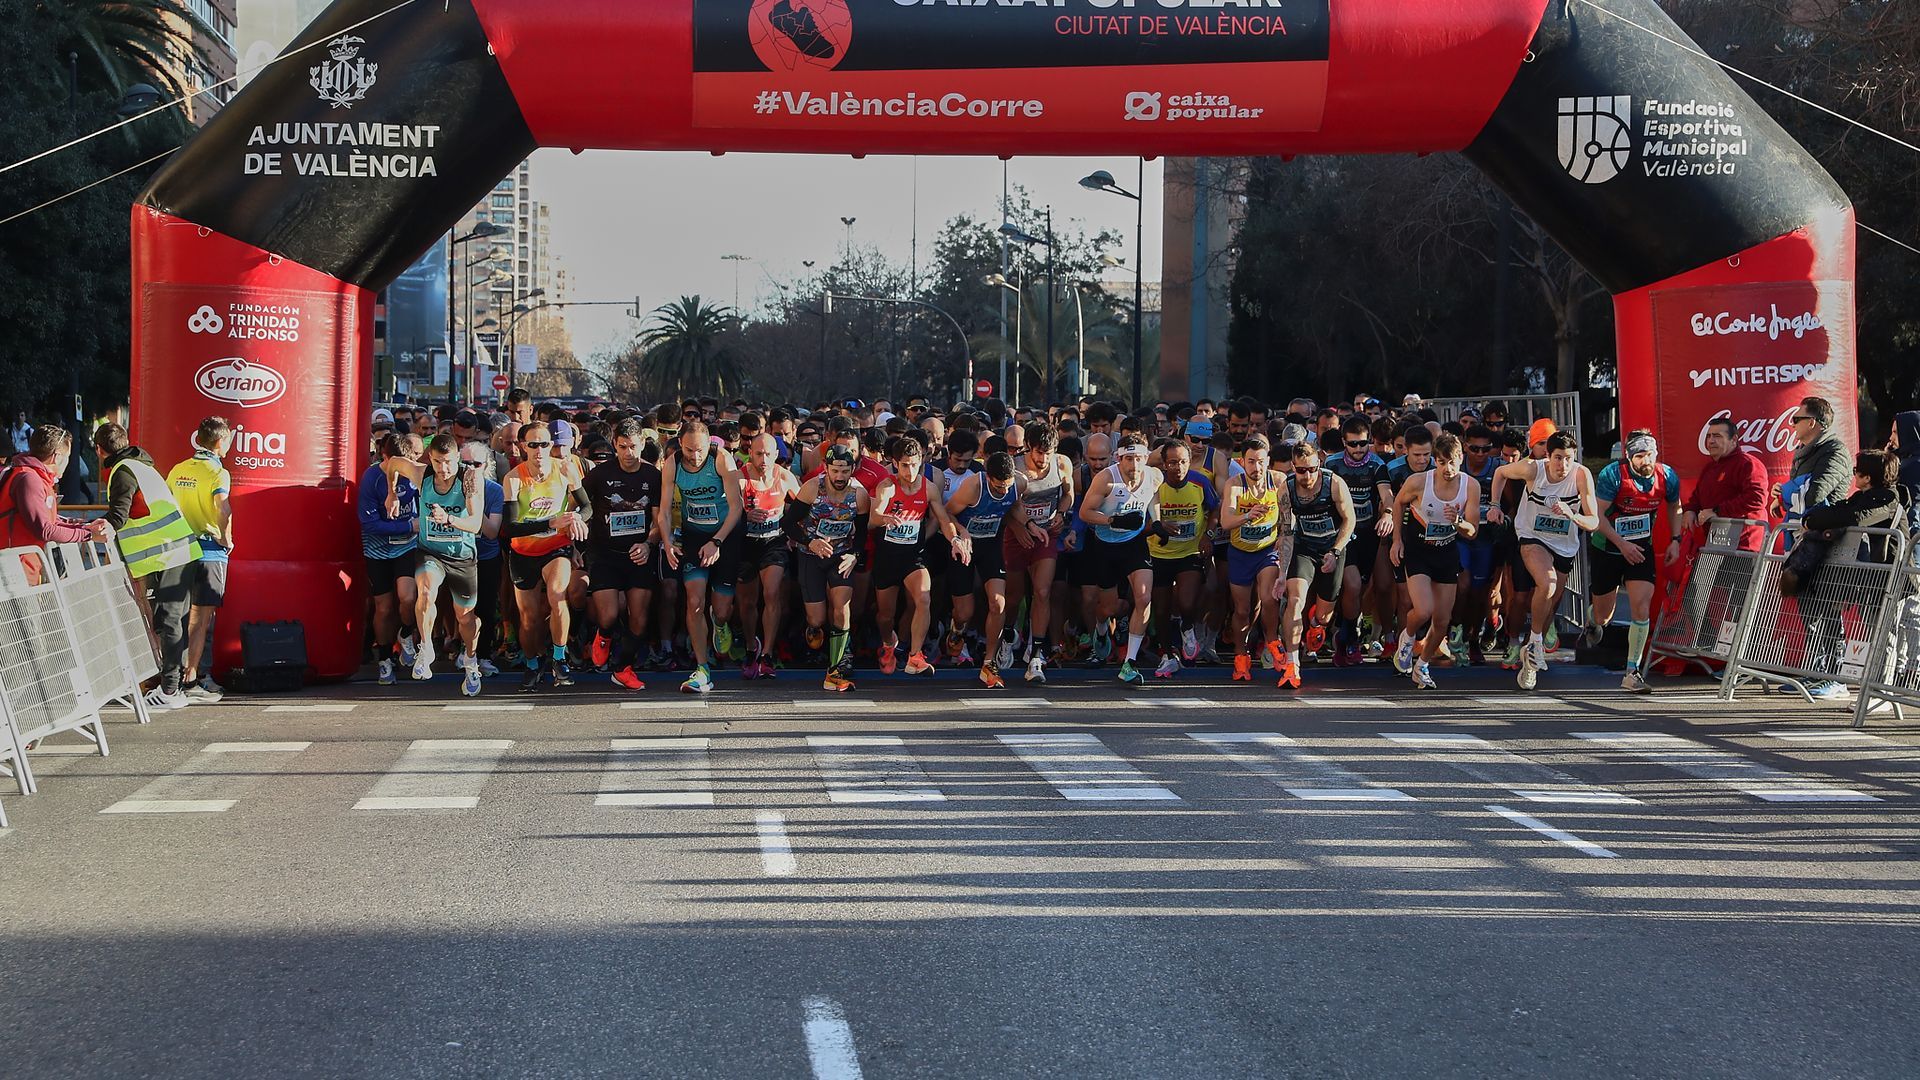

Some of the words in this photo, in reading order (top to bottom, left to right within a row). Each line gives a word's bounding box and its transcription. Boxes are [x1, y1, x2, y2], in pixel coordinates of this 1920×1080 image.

[1054, 16, 1132, 35] CIUTAT
[1139, 16, 1168, 35] DE
[1175, 11, 1286, 36] VALÈNCIA
[753, 91, 1044, 117] #ValènciaCorre
[1168, 92, 1230, 106] caixa
[1166, 105, 1263, 121] popular
[1643, 99, 1735, 118] Fundació
[247, 122, 440, 148] AJUNTAMENT
[1643, 119, 1742, 139] Esportiva
[1642, 137, 1747, 159] Municipal
[244, 153, 282, 175] DE
[292, 149, 437, 178] VALÈNCIA
[1642, 159, 1735, 177] València
[229, 303, 300, 315] FUNDACIÓN
[228, 313, 300, 329] TRINIDAD
[1690, 312, 1715, 336] El
[1714, 312, 1767, 335] Corte
[228, 327, 299, 342] ALFONSO
[204, 370, 276, 393] Serrano
[235, 456, 284, 469] seguros
[616, 515, 638, 526] 2132
[1305, 520, 1327, 531] 2216
[1620, 519, 1643, 531] 2160
[892, 525, 914, 535] 2078
[1245, 526, 1267, 536] 2222
[1432, 524, 1454, 534] 251
